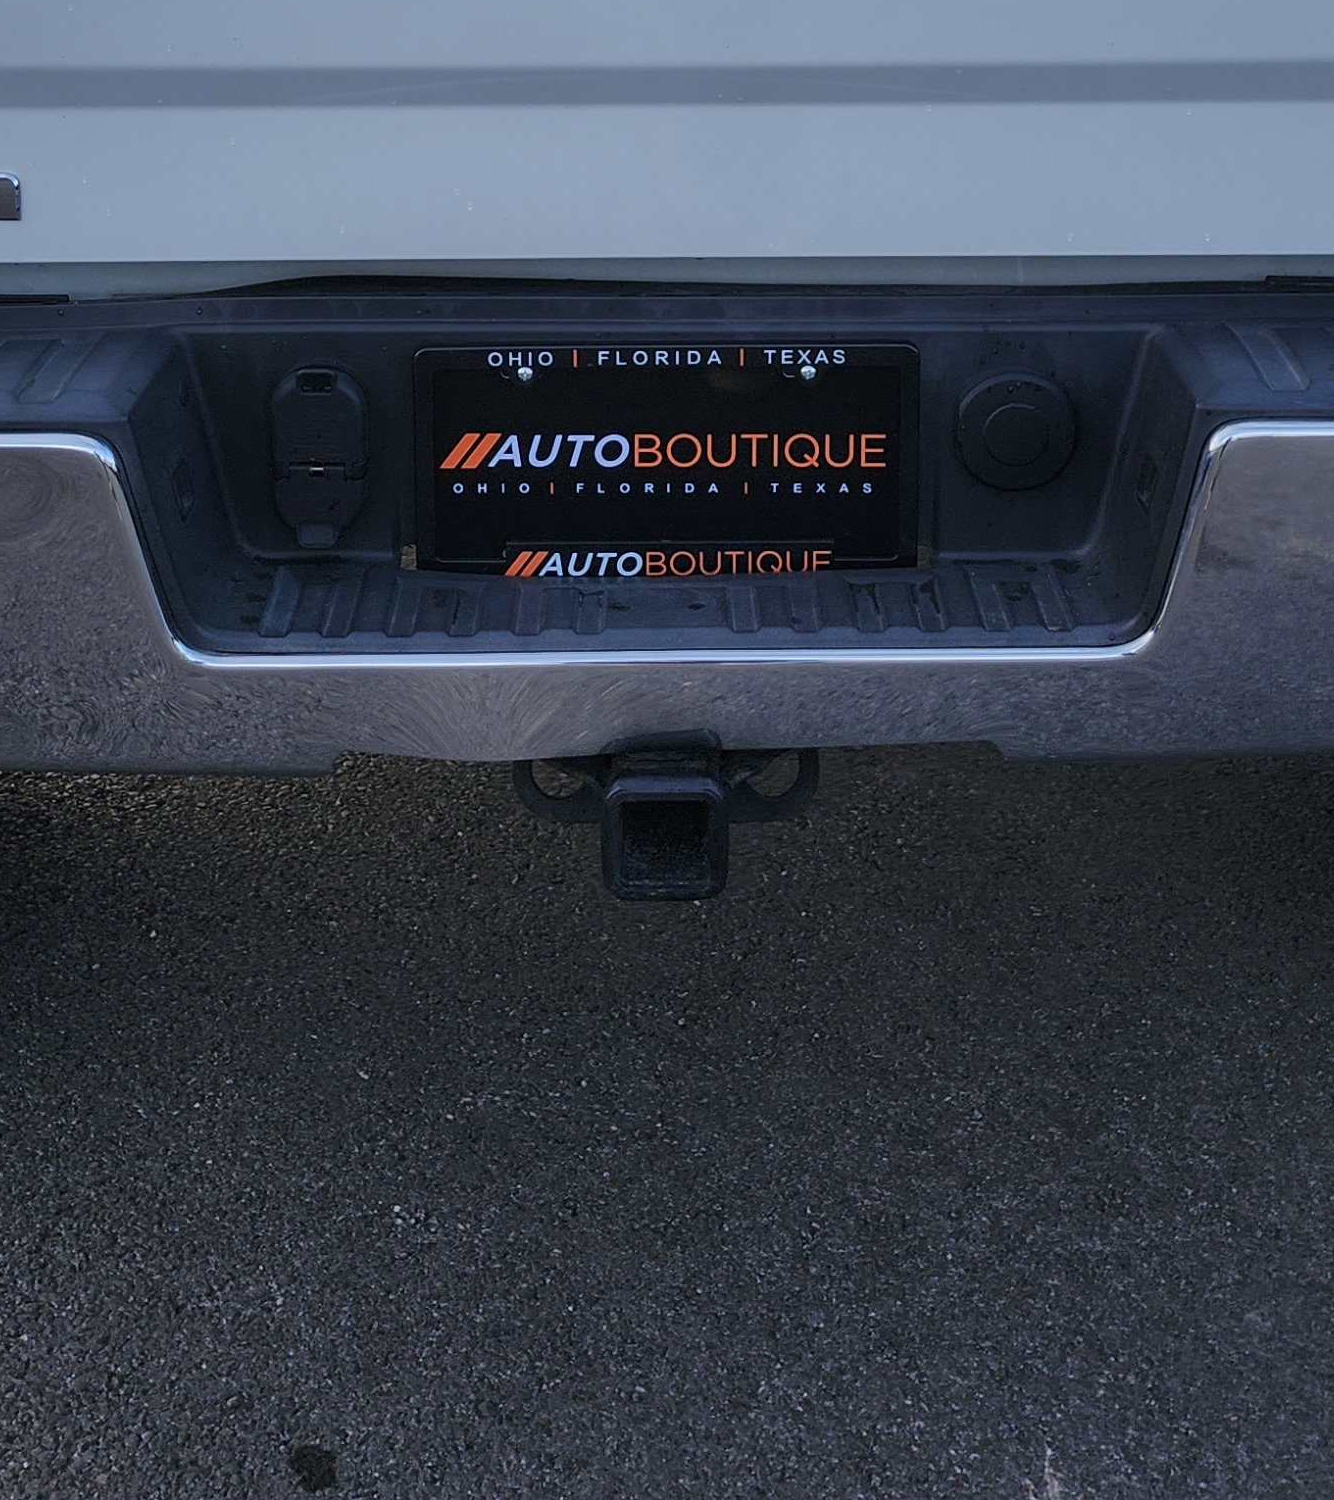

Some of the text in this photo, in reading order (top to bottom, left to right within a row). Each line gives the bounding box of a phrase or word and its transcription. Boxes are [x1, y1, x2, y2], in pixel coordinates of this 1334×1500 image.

[487, 348, 847, 367] OHIO FLORIDA TEXAS
[488, 432, 888, 469] AUTOBOUTIQUE
[452, 482, 874, 495] OHIO FLORIDA TEXAS
